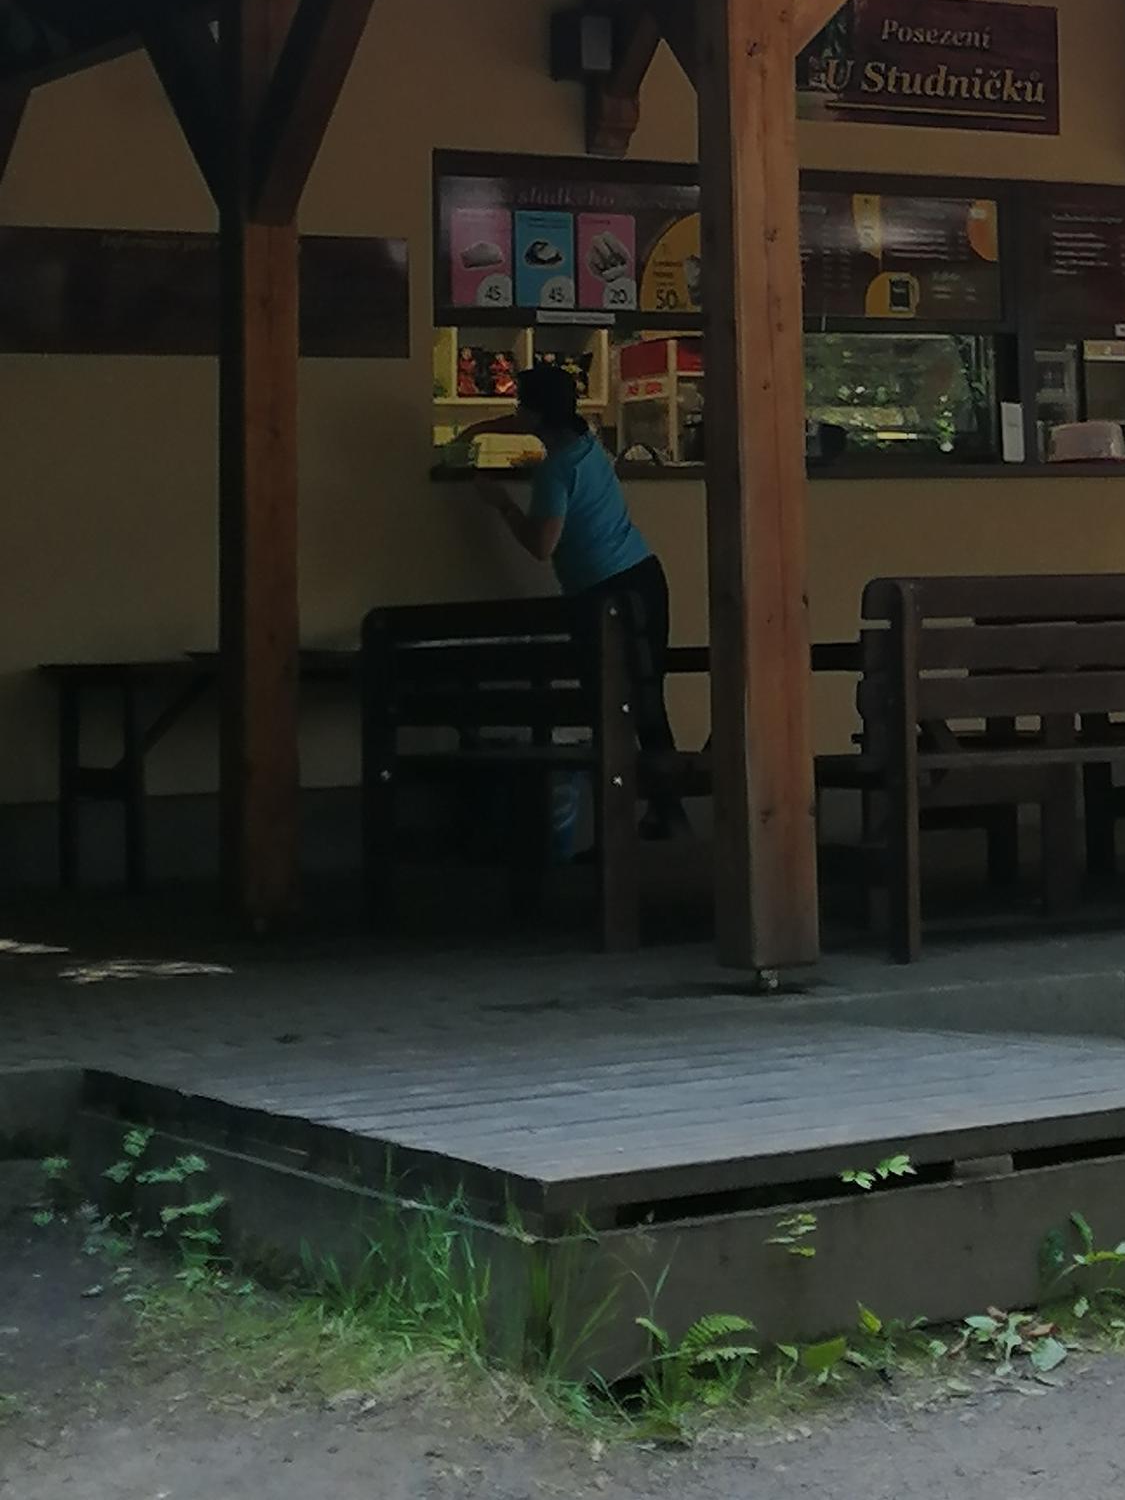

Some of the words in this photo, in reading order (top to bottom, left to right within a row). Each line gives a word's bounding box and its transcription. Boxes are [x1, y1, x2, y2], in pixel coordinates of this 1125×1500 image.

[881, 18, 991, 49] Posezení
[826, 58, 854, 91] U
[860, 60, 1046, 104] Studničků
